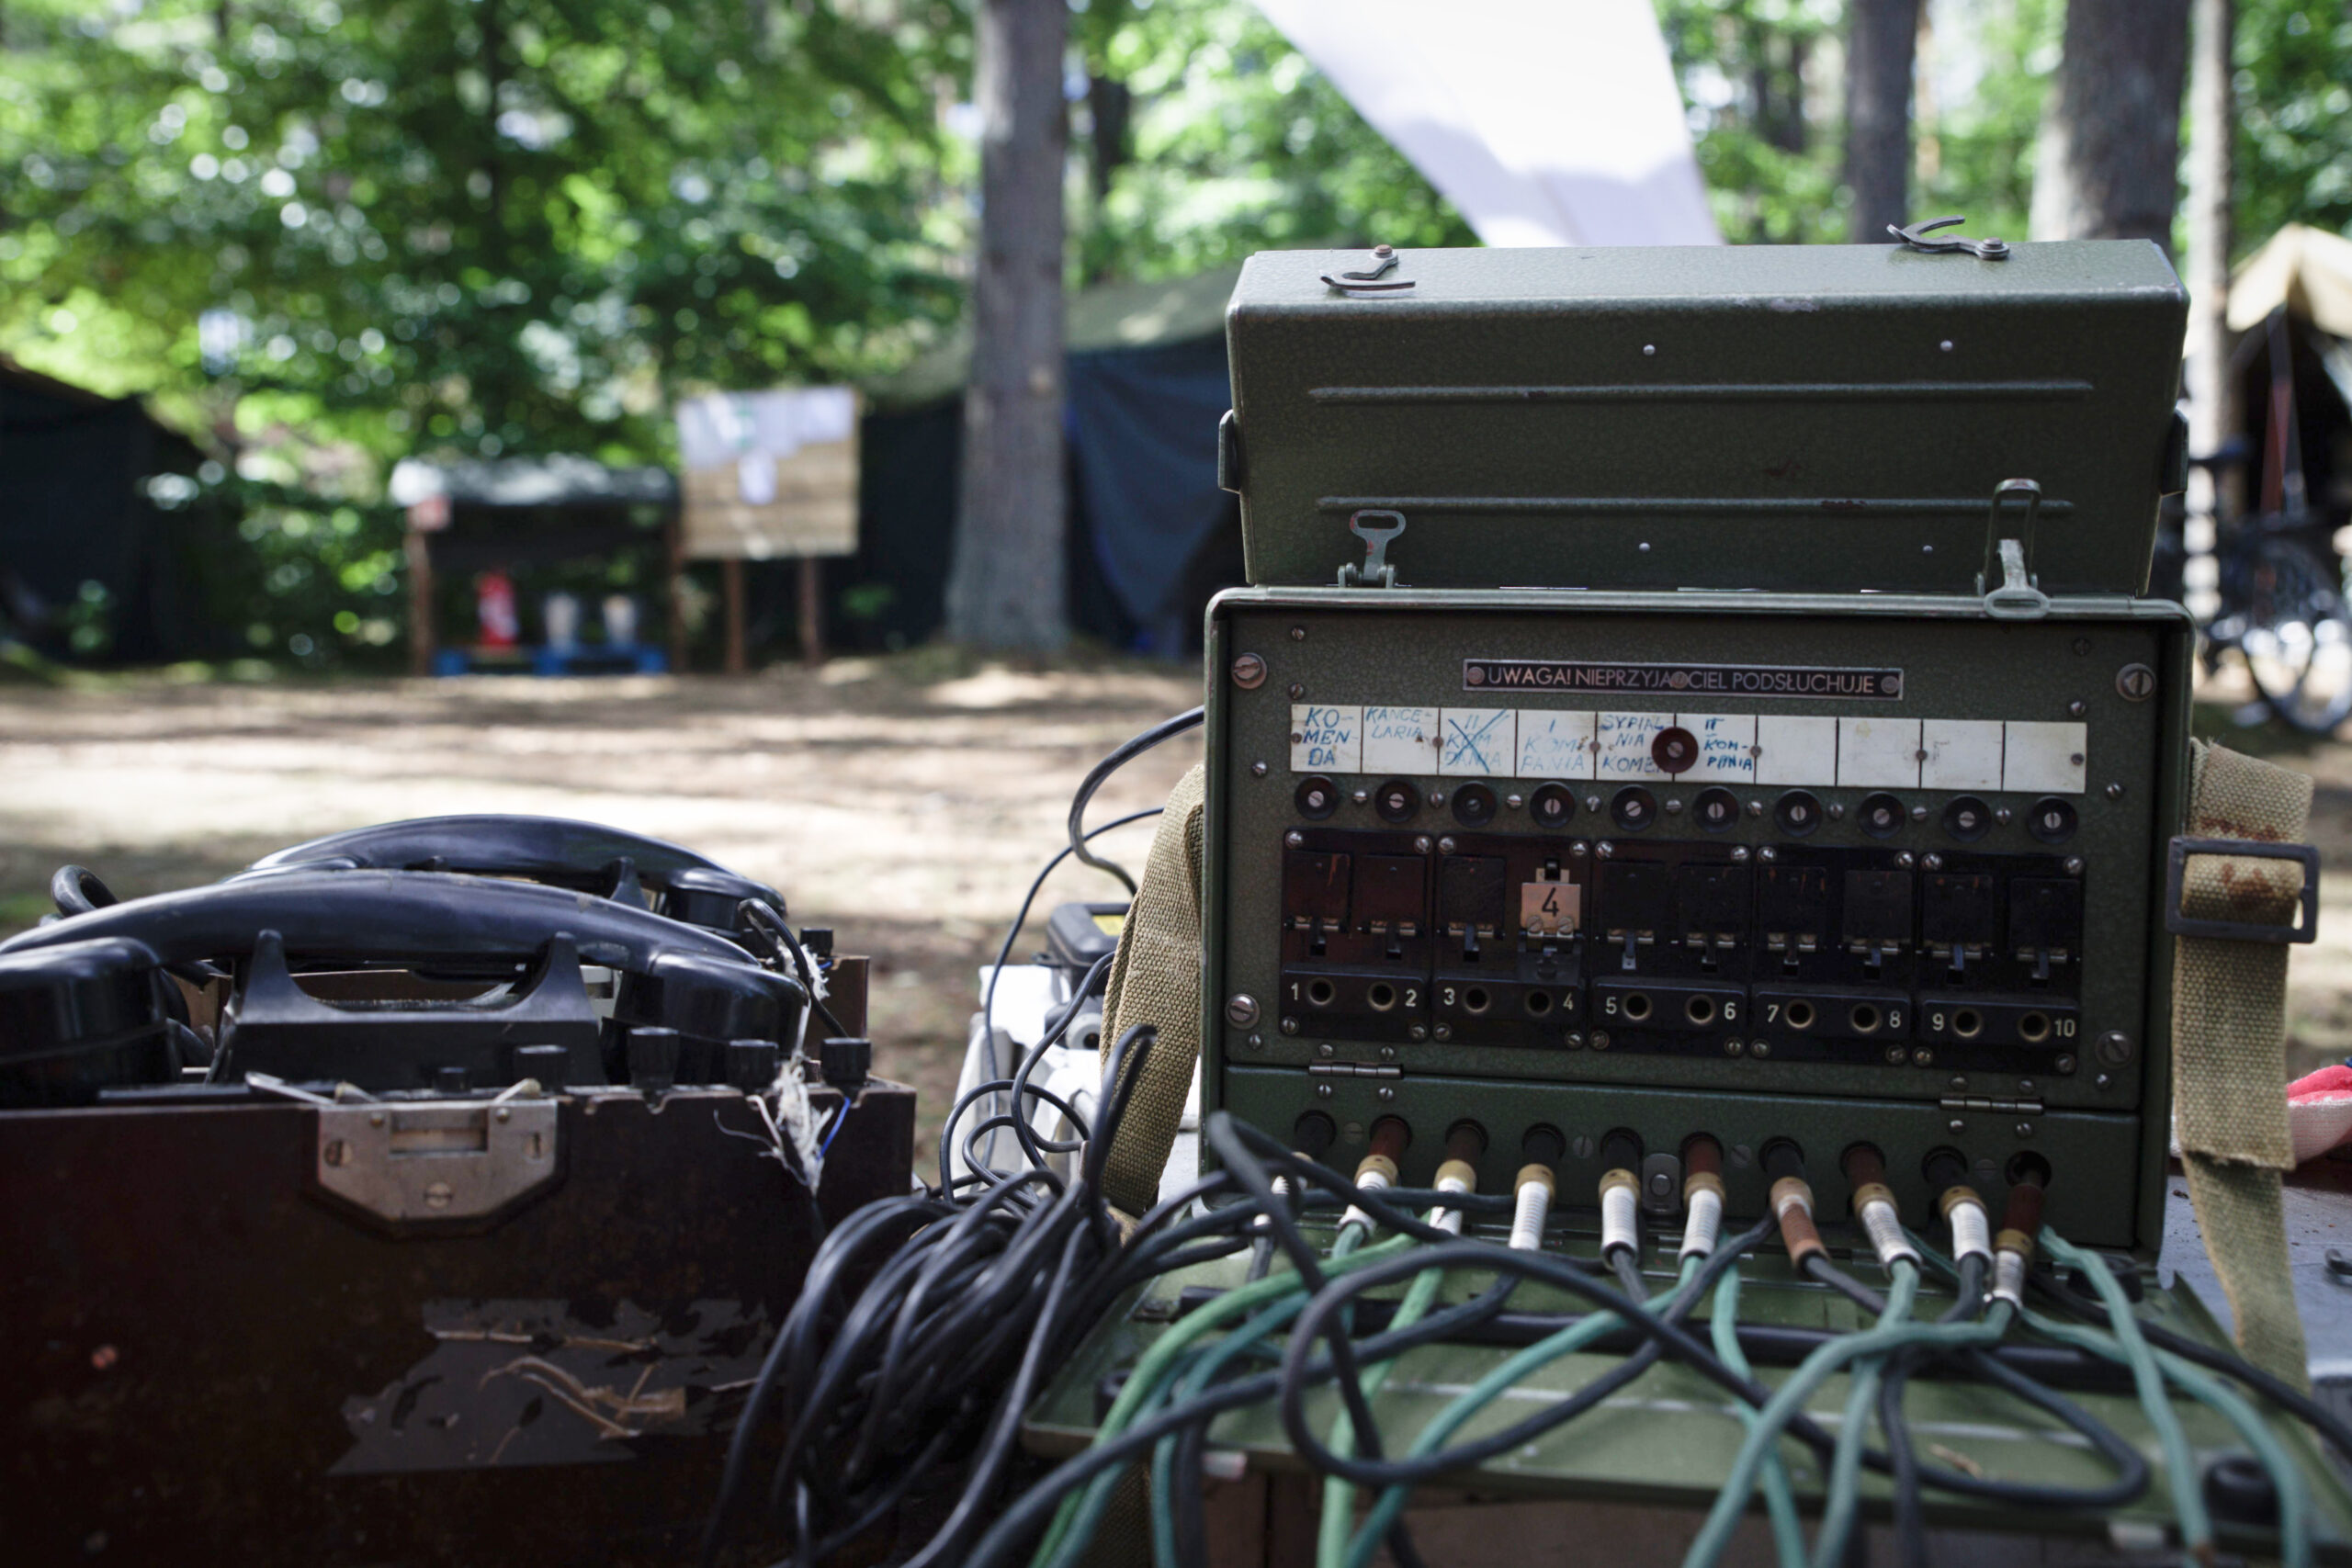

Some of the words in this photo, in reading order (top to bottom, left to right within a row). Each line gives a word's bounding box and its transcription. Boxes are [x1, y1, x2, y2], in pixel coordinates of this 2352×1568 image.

[1487, 666, 1571, 685] UWAGA!
[1575, 668, 1727, 690] NIEPRZYJACIEL
[1732, 671, 1875, 694] PODSŁUCHUJE
[1615, 732, 1645, 747] NIA
[1308, 747, 1336, 766] DA
[1541, 886, 1560, 917] 4
[1290, 983, 1300, 1001] 1
[1405, 988, 1417, 1008] 2
[1443, 987, 1456, 1006] 3
[1563, 992, 1574, 1010] 4
[1605, 997, 1618, 1015] 5
[1724, 1001, 1736, 1020] 6
[1767, 1005, 1780, 1023] 7
[1889, 1010, 1902, 1029] 8
[1932, 1013, 1945, 1032] 9
[2054, 1019, 2076, 1038] 10
